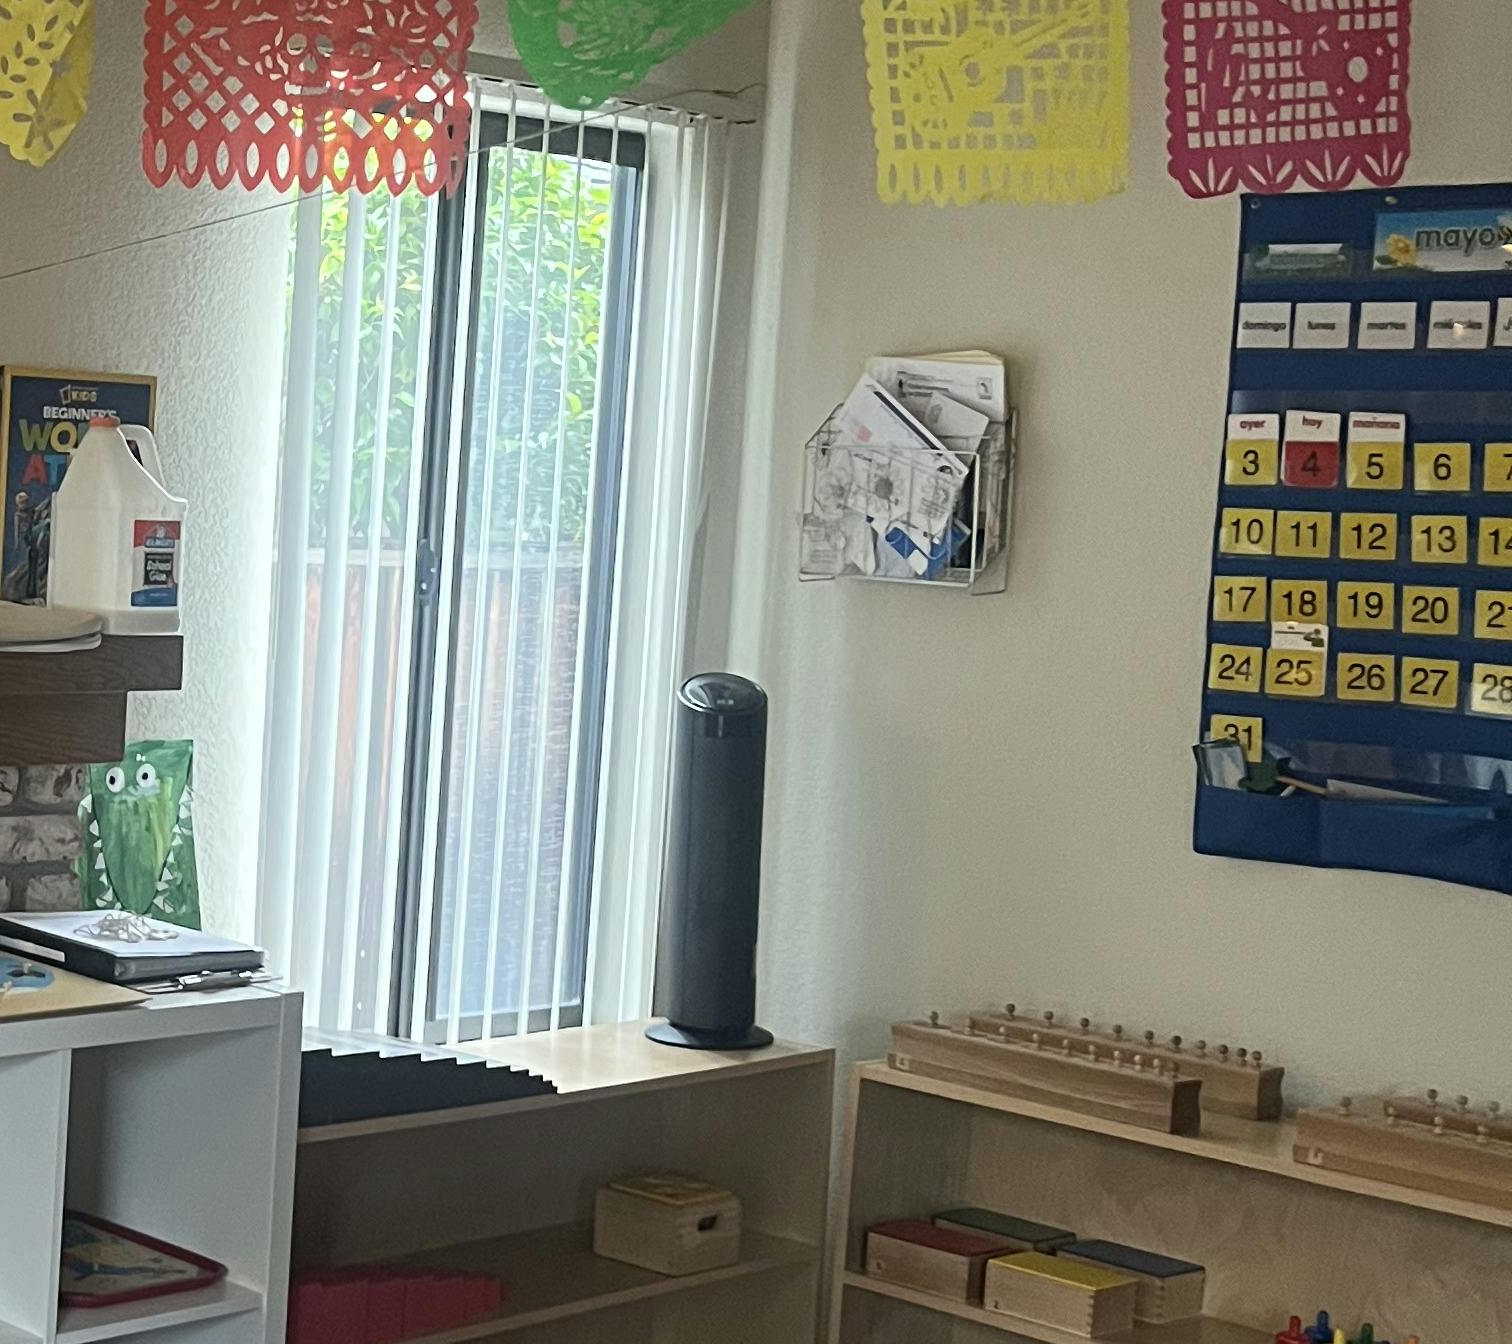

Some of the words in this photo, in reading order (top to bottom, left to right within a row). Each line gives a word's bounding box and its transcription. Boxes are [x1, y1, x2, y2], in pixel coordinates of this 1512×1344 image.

[1415, 226, 1496, 257] mayo
[1239, 420, 1266, 431] ayer
[1302, 415, 1324, 429] hoy
[22, 454, 70, 486] AT
[1242, 449, 1260, 476] 3
[1300, 450, 1320, 477] 4
[1365, 452, 1385, 480] 5
[1433, 453, 1452, 481] 6
[1230, 517, 1264, 545] 10
[1289, 520, 1318, 548] 11
[1351, 522, 1387, 550] 12
[1420, 524, 1457, 553] 13
[1223, 586, 1257, 613] 17
[1281, 589, 1317, 617] 18
[1347, 590, 1384, 619] 19
[1410, 594, 1449, 624] 20
[1217, 653, 1252, 682] 24
[1274, 657, 1313, 686] 25
[1346, 662, 1386, 691] 26
[1409, 666, 1449, 697] 27
[1480, 673, 1512, 704] 28
[1223, 722, 1252, 752] 31
